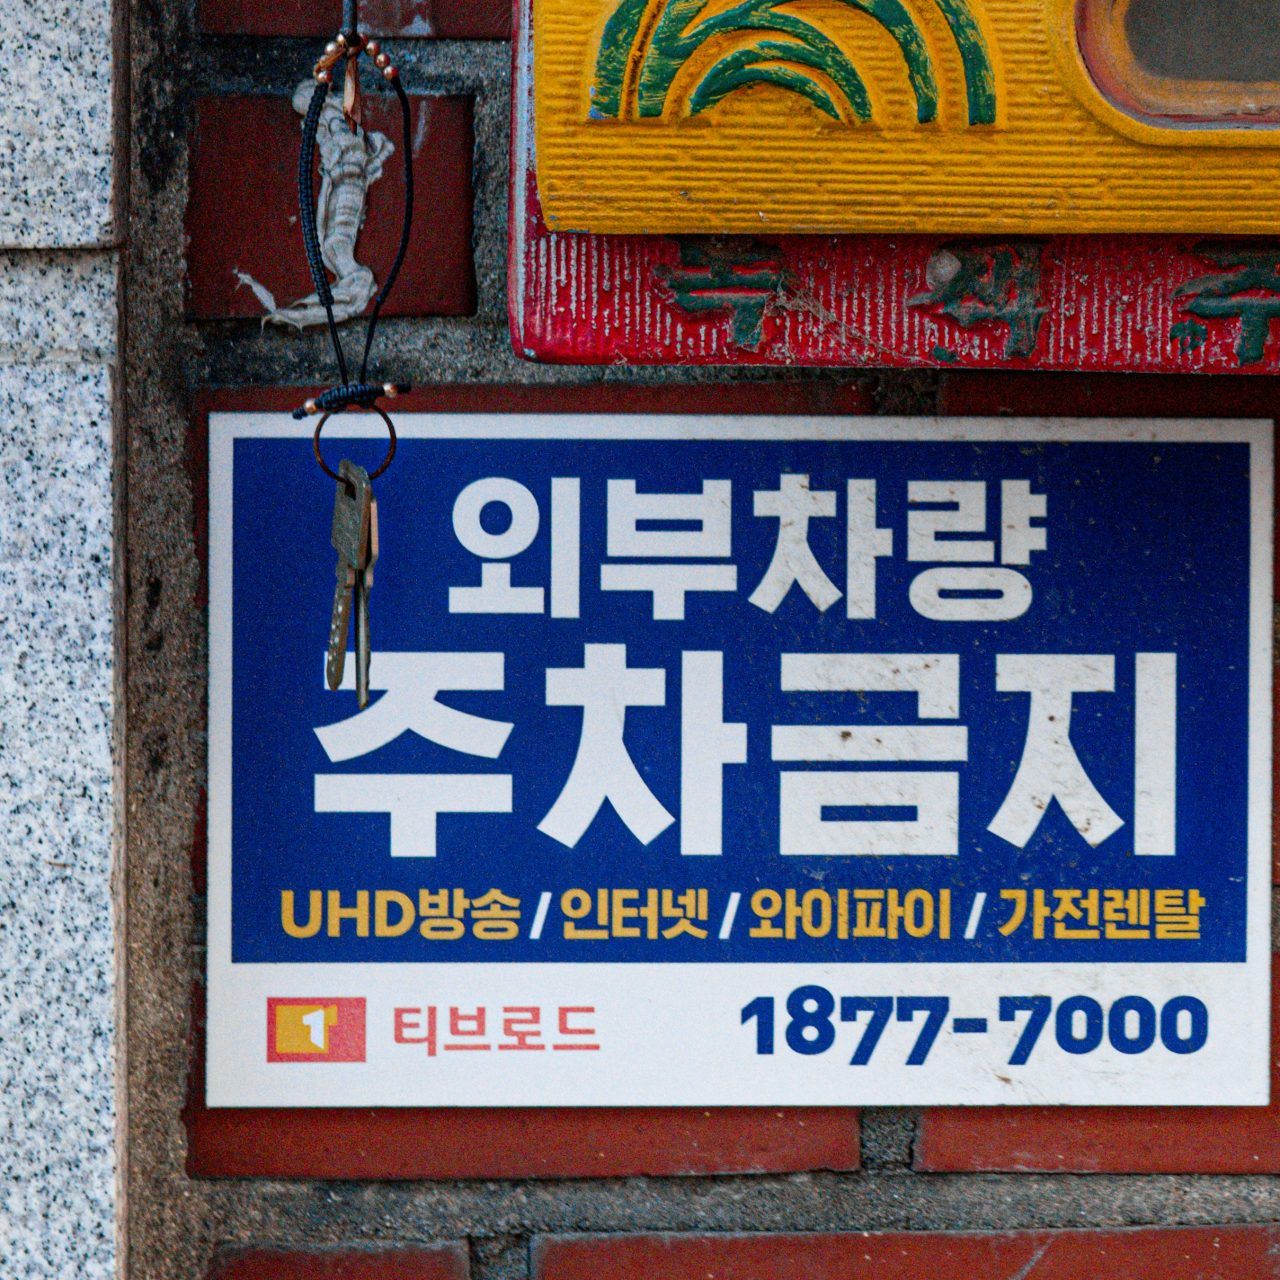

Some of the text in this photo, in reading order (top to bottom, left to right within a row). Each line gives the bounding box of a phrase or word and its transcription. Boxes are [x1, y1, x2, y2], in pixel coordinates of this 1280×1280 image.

[447, 473, 1049, 623] 외부차량
[311, 642, 1178, 858] 주차금지
[280, 887, 522, 940] UHD방송
[560, 887, 709, 940] 인터넷
[748, 888, 951, 940] 와이파이
[998, 888, 1206, 940] 가전렌탈
[393, 1005, 601, 1057] 티브로드
[740, 984, 1210, 1067] 1877-7000
